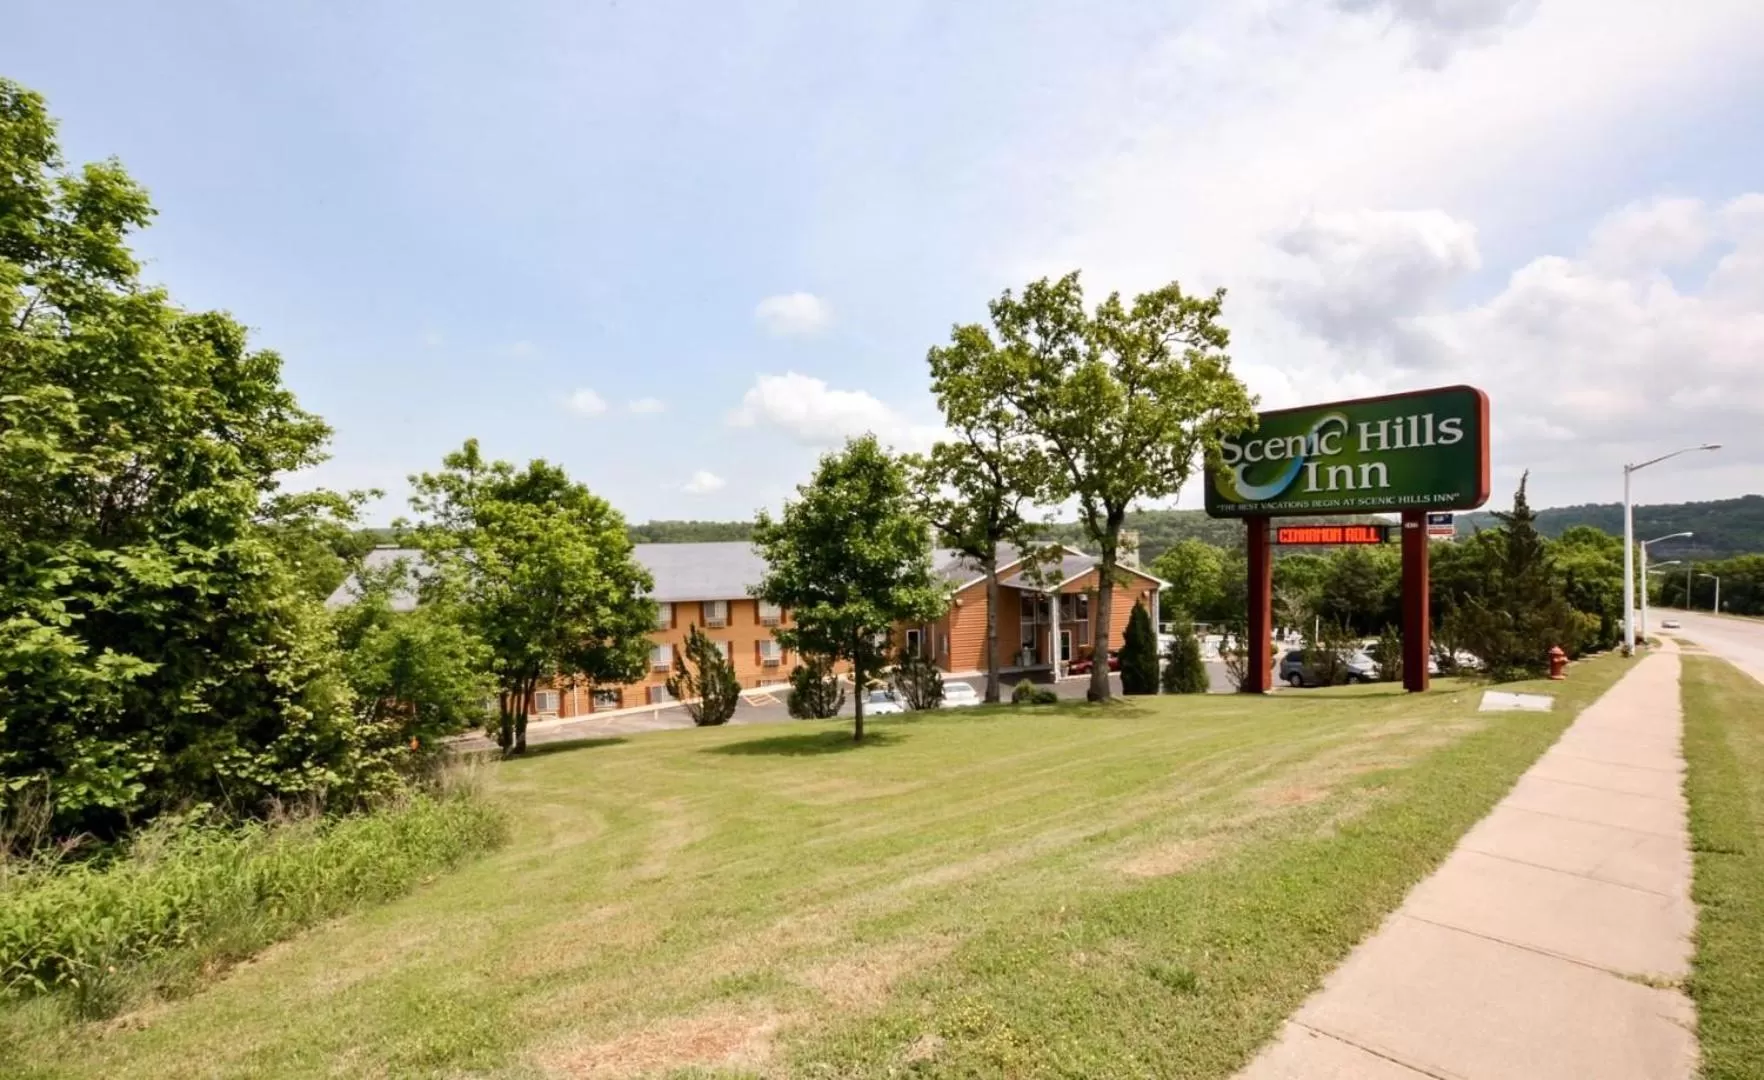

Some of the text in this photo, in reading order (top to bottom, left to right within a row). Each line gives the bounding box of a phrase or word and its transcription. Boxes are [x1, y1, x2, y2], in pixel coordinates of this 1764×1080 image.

[1220, 413, 1464, 464] Scenic Hills
[1303, 460, 1391, 493] Inn
[1261, 500, 1310, 510] VACATIONS
[1311, 499, 1341, 508] BEGIN
[1343, 498, 1355, 507] AT
[1358, 496, 1395, 506] SCENIC
[1399, 493, 1431, 504] HILLS
[1345, 527, 1380, 542] ROLL
